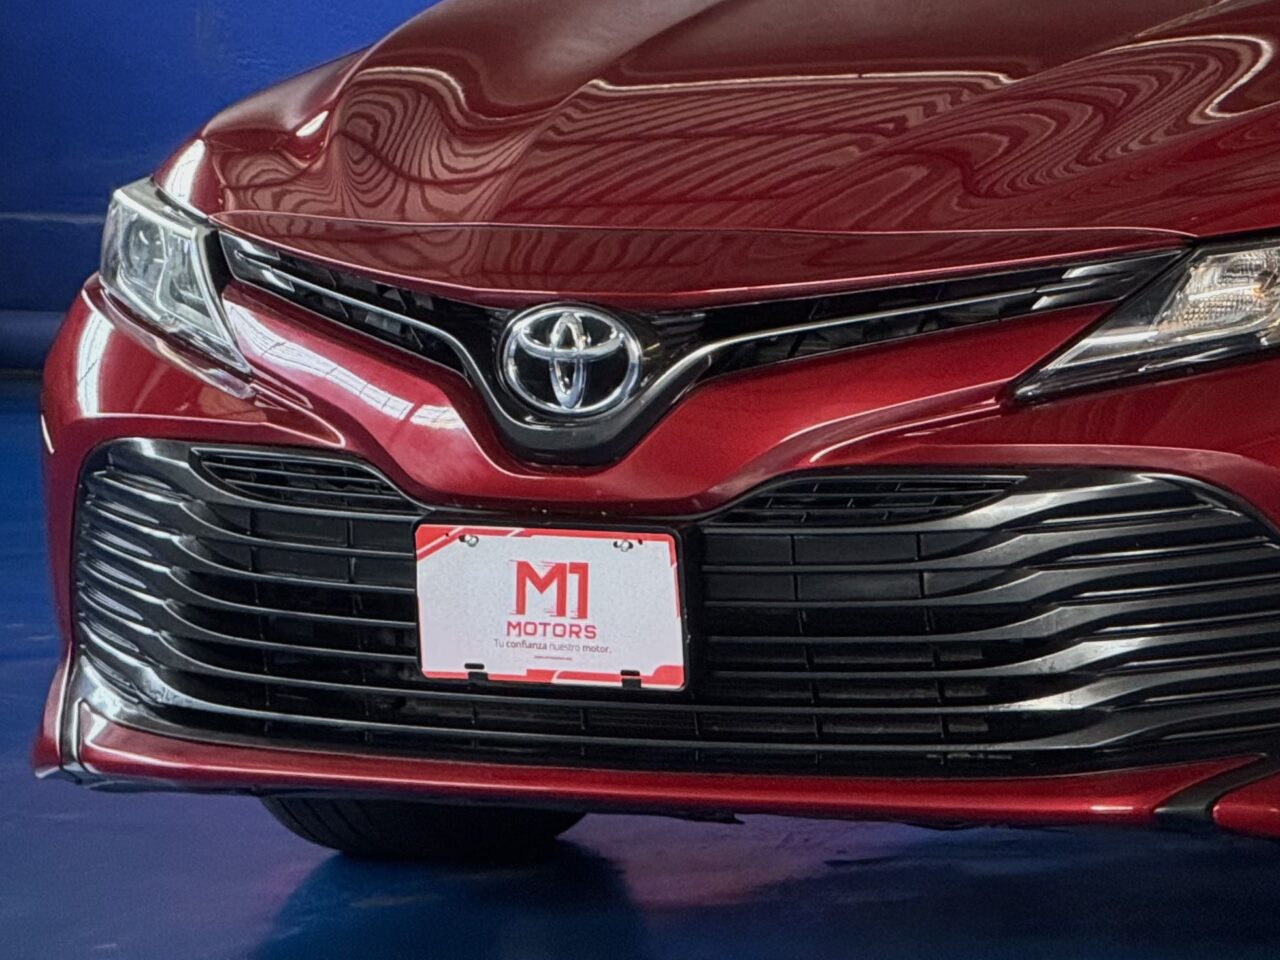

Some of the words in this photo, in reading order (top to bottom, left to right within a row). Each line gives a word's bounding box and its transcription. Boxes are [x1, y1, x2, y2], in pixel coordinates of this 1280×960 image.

[510, 559, 589, 619] M1
[506, 620, 597, 640] MOTORS
[493, 638, 505, 649] Tu
[505, 640, 547, 651] confianza
[549, 643, 581, 653] nuestro
[582, 645, 613, 655] motor.
